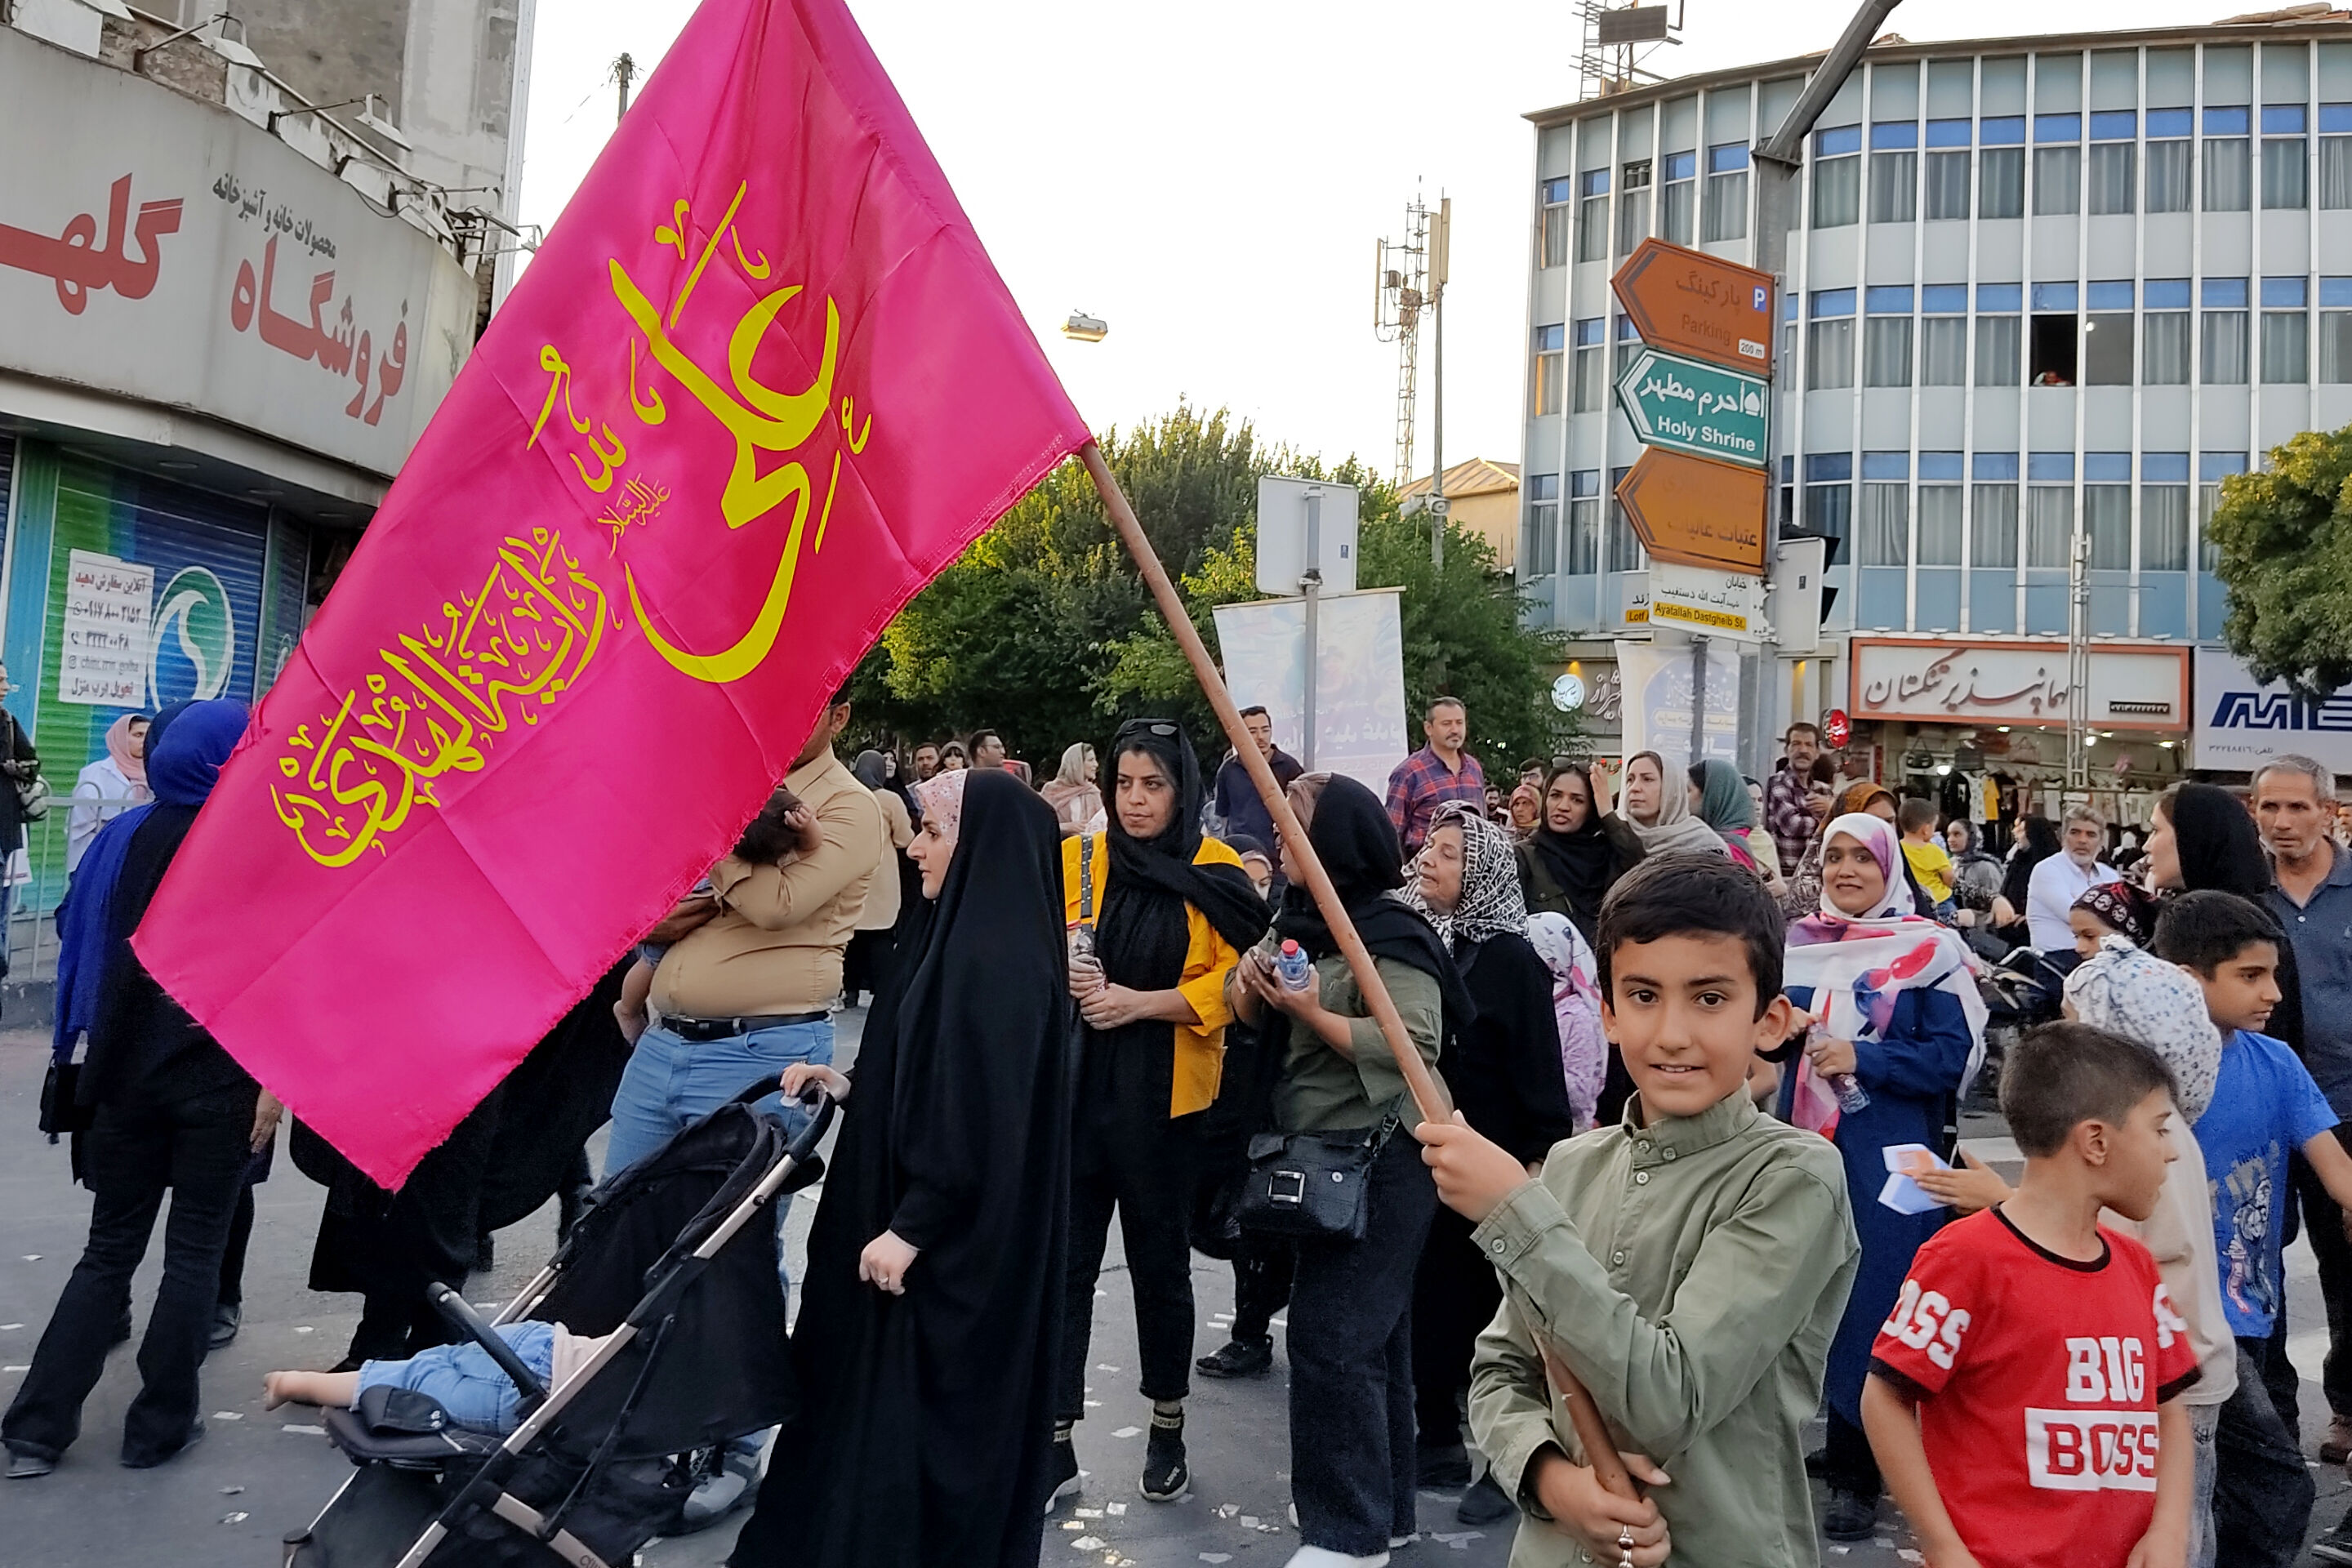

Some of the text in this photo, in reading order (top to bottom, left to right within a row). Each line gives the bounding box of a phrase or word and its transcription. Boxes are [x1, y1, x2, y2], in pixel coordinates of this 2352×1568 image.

[263, 208, 271, 233] و
[273, 203, 294, 234] خانه
[294, 218, 336, 260] محصولات
[1675, 270, 1741, 315] پارکینگ
[1753, 287, 1766, 310] P
[230, 233, 408, 427] فروشگاه
[1681, 314, 1731, 347] Parking
[1740, 341, 1755, 355] 200
[1639, 372, 1740, 416] حرم مطهر
[1657, 415, 1757, 452] Holy Shrine
[95, 573, 122, 592] سفارش
[1660, 586, 1696, 599] دستغیب
[1725, 575, 1748, 592] خیابان
[1697, 589, 1708, 602] الله
[1709, 592, 1727, 608] آیت
[71, 677, 90, 697] منزل
[91, 683, 109, 697] درب
[2065, 1336, 2145, 1403] BIG
[2045, 1423, 2158, 1477] BOSS
